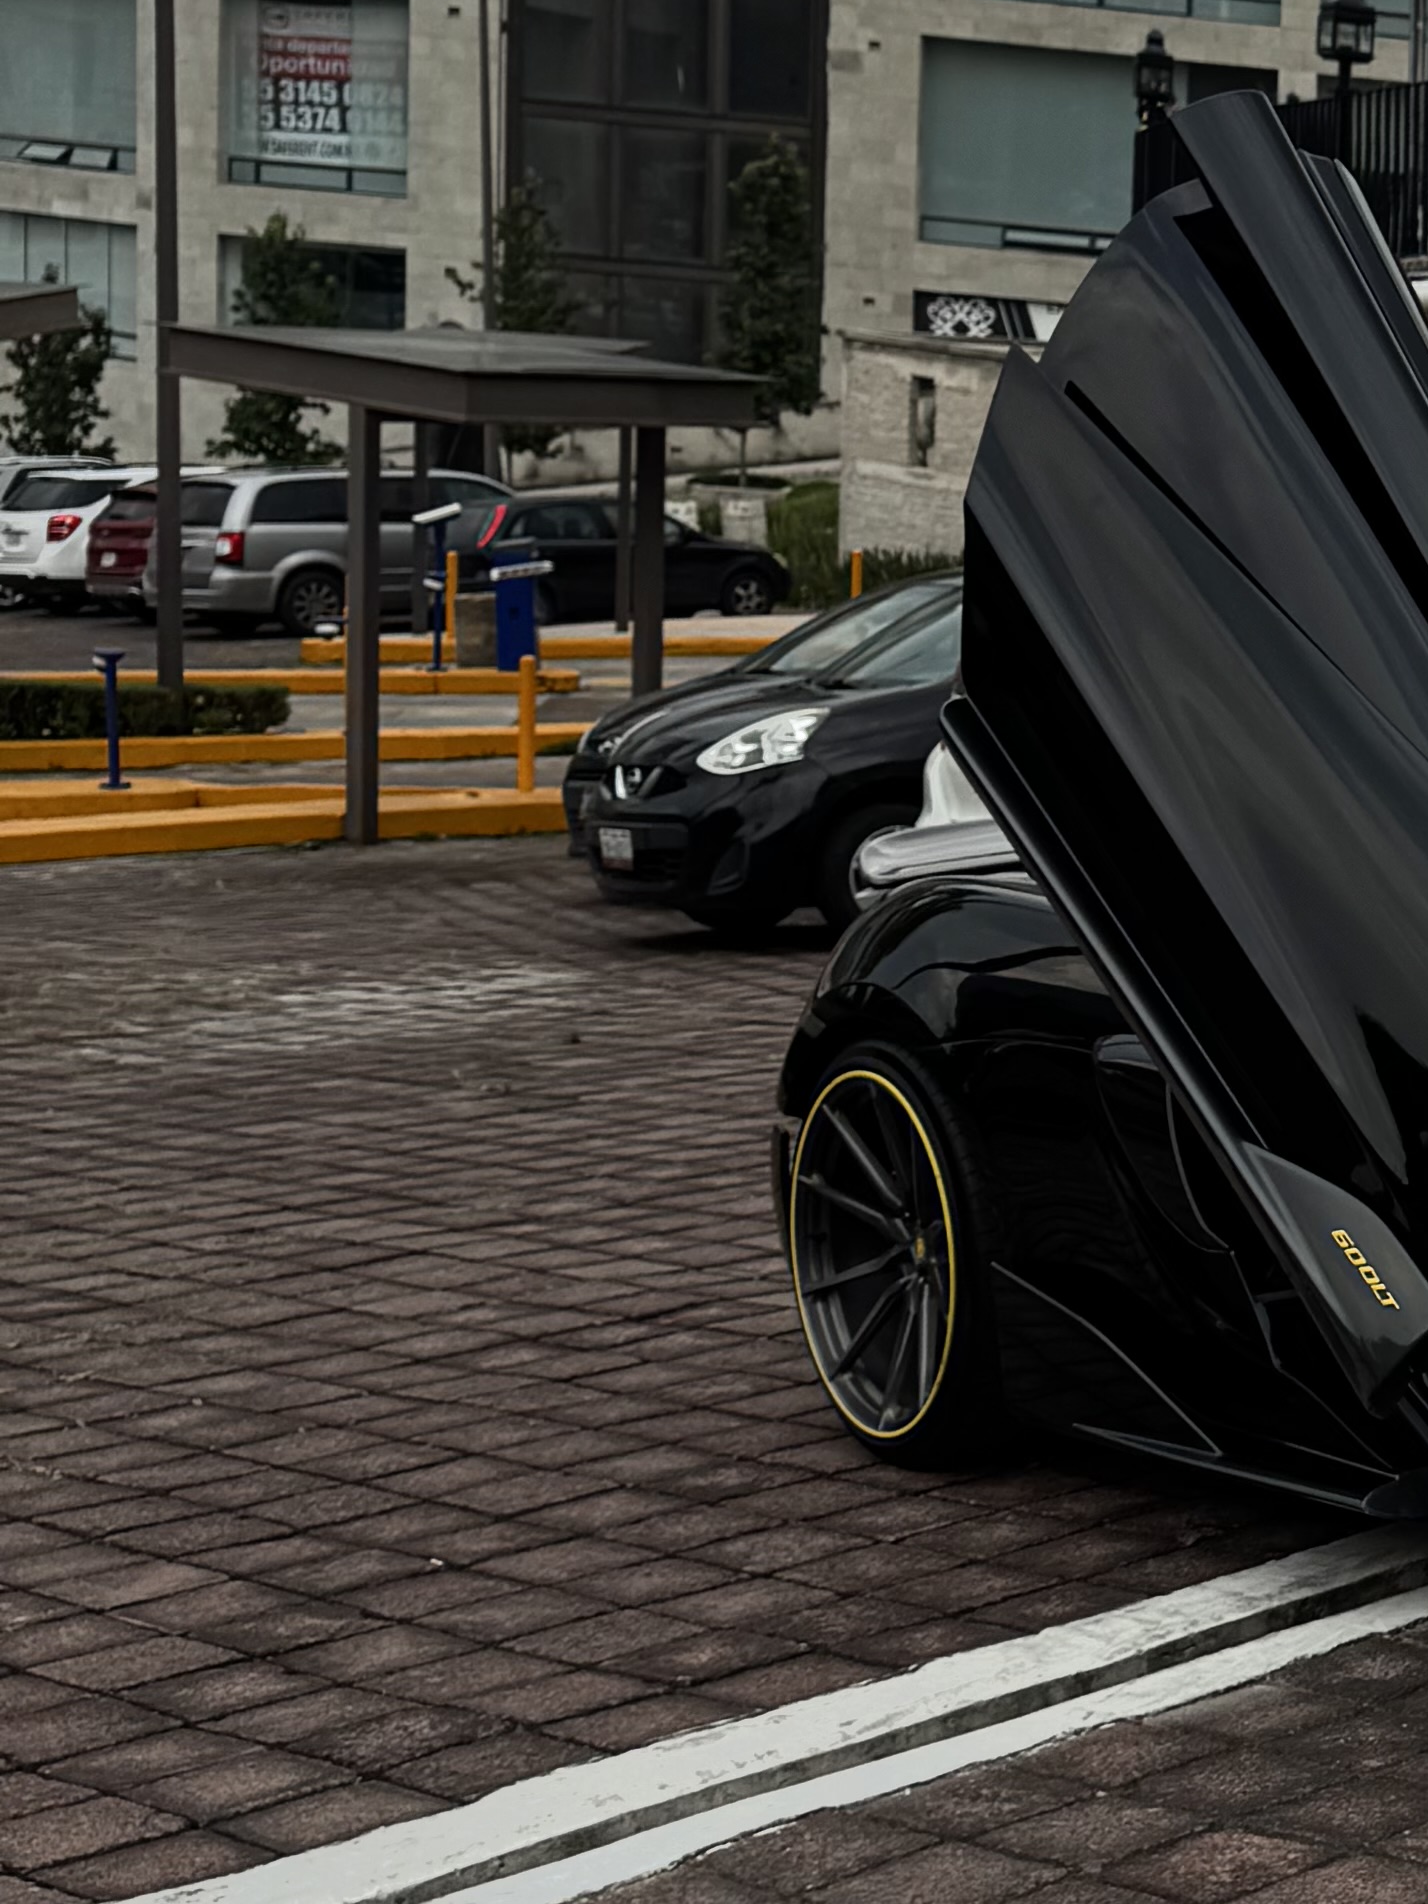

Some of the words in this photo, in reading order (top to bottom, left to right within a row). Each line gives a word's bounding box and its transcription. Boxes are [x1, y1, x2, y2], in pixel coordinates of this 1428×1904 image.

[279, 78, 338, 106] 3145
[280, 104, 341, 132] 5374
[1331, 1229, 1400, 1310] 600LT
